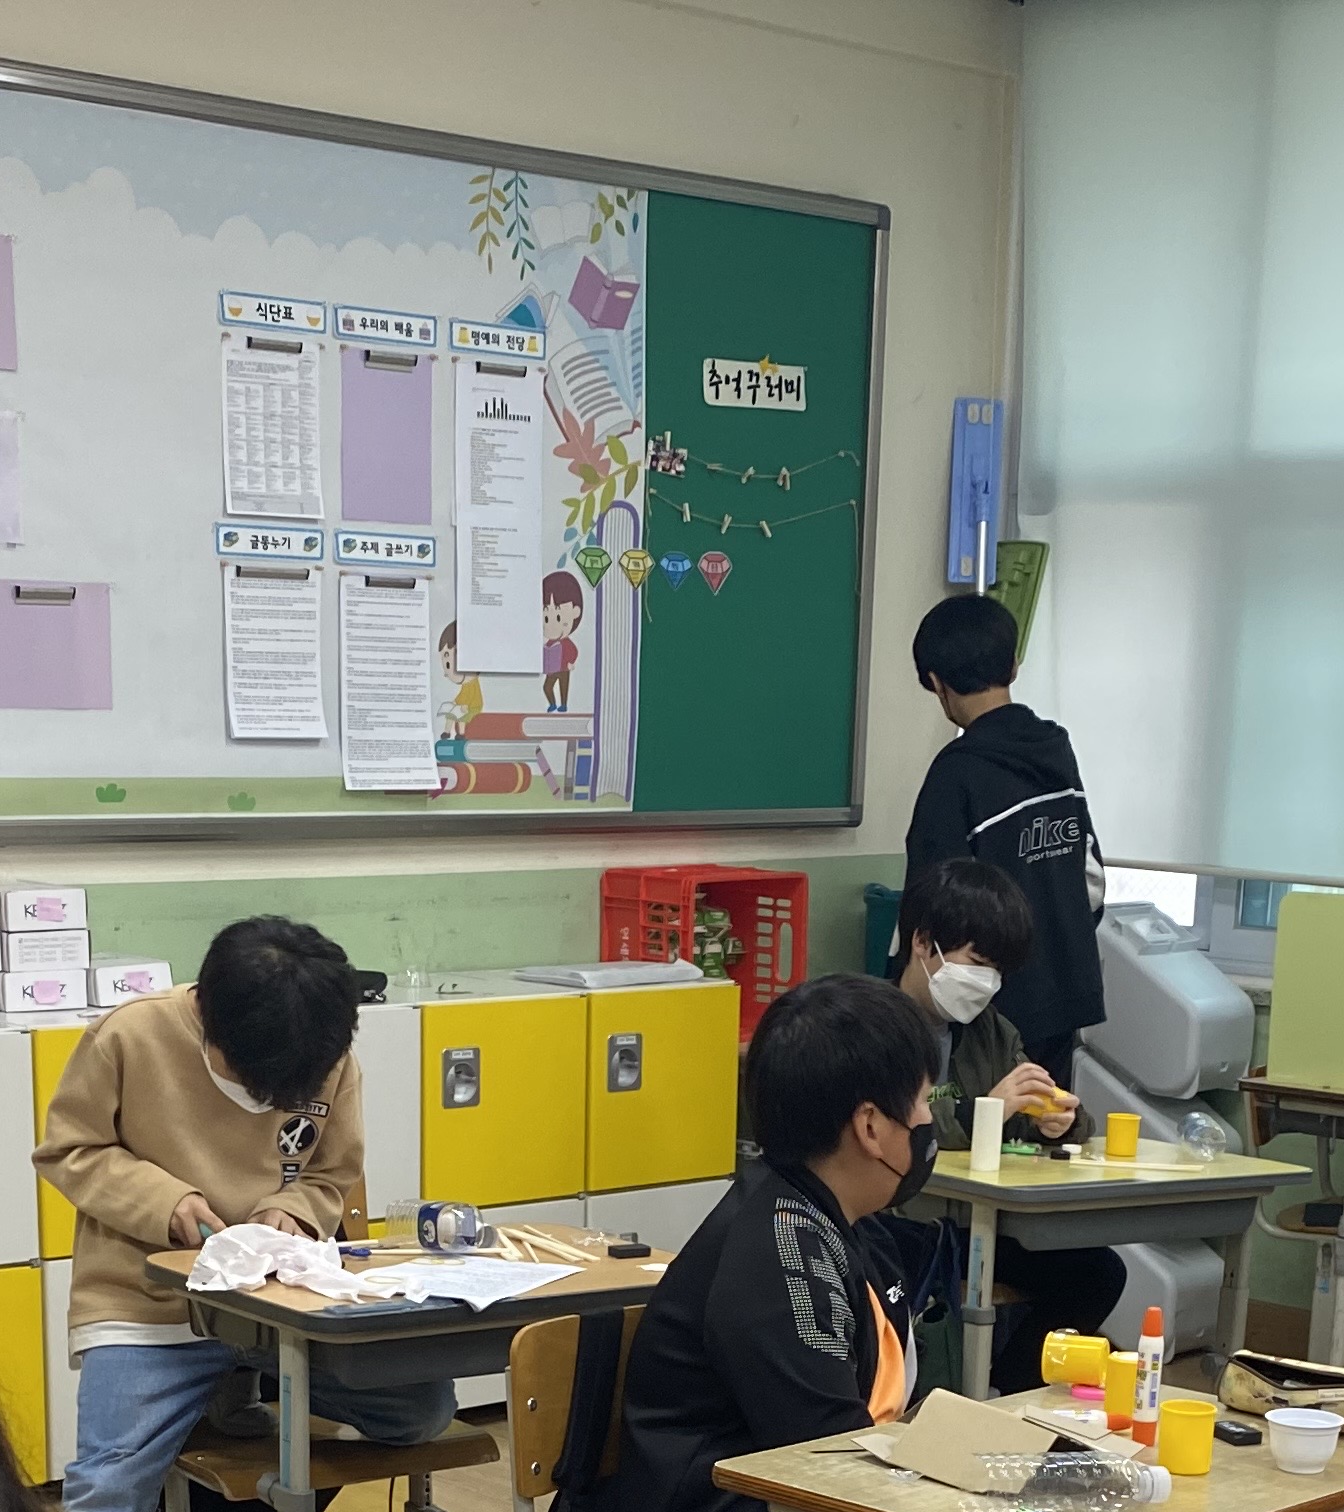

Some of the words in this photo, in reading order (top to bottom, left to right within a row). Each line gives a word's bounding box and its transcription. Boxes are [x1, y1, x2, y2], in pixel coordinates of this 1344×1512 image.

[255, 302, 296, 323] 식단표
[359, 316, 390, 334] 우리의
[393, 321, 414, 338] 배움
[471, 329, 501, 347] 명예의
[505, 334, 527, 352] 전당
[360, 540, 380, 556] 주제
[384, 541, 414, 558] 글쓰기
